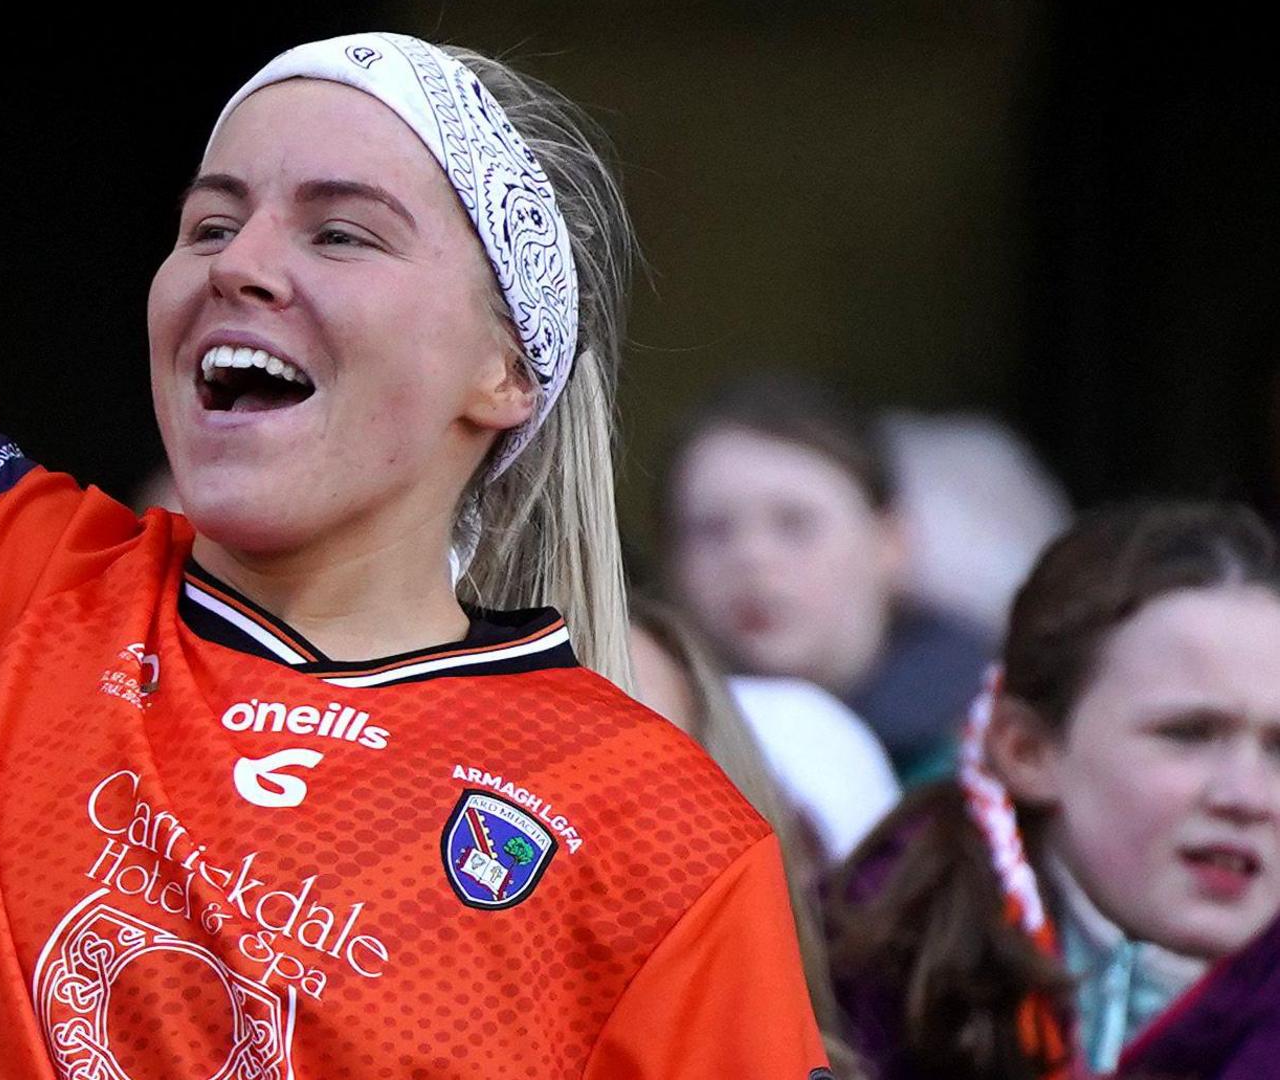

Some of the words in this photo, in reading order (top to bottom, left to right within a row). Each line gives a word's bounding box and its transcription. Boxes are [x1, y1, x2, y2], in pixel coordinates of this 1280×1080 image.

[234, 748, 325, 808] 6
[452, 765, 543, 813] ARMAGH
[539, 804, 584, 855] LGFA
[85, 838, 195, 920] Hotel
[201, 902, 233, 935] &
[238, 930, 328, 1001] Spa
